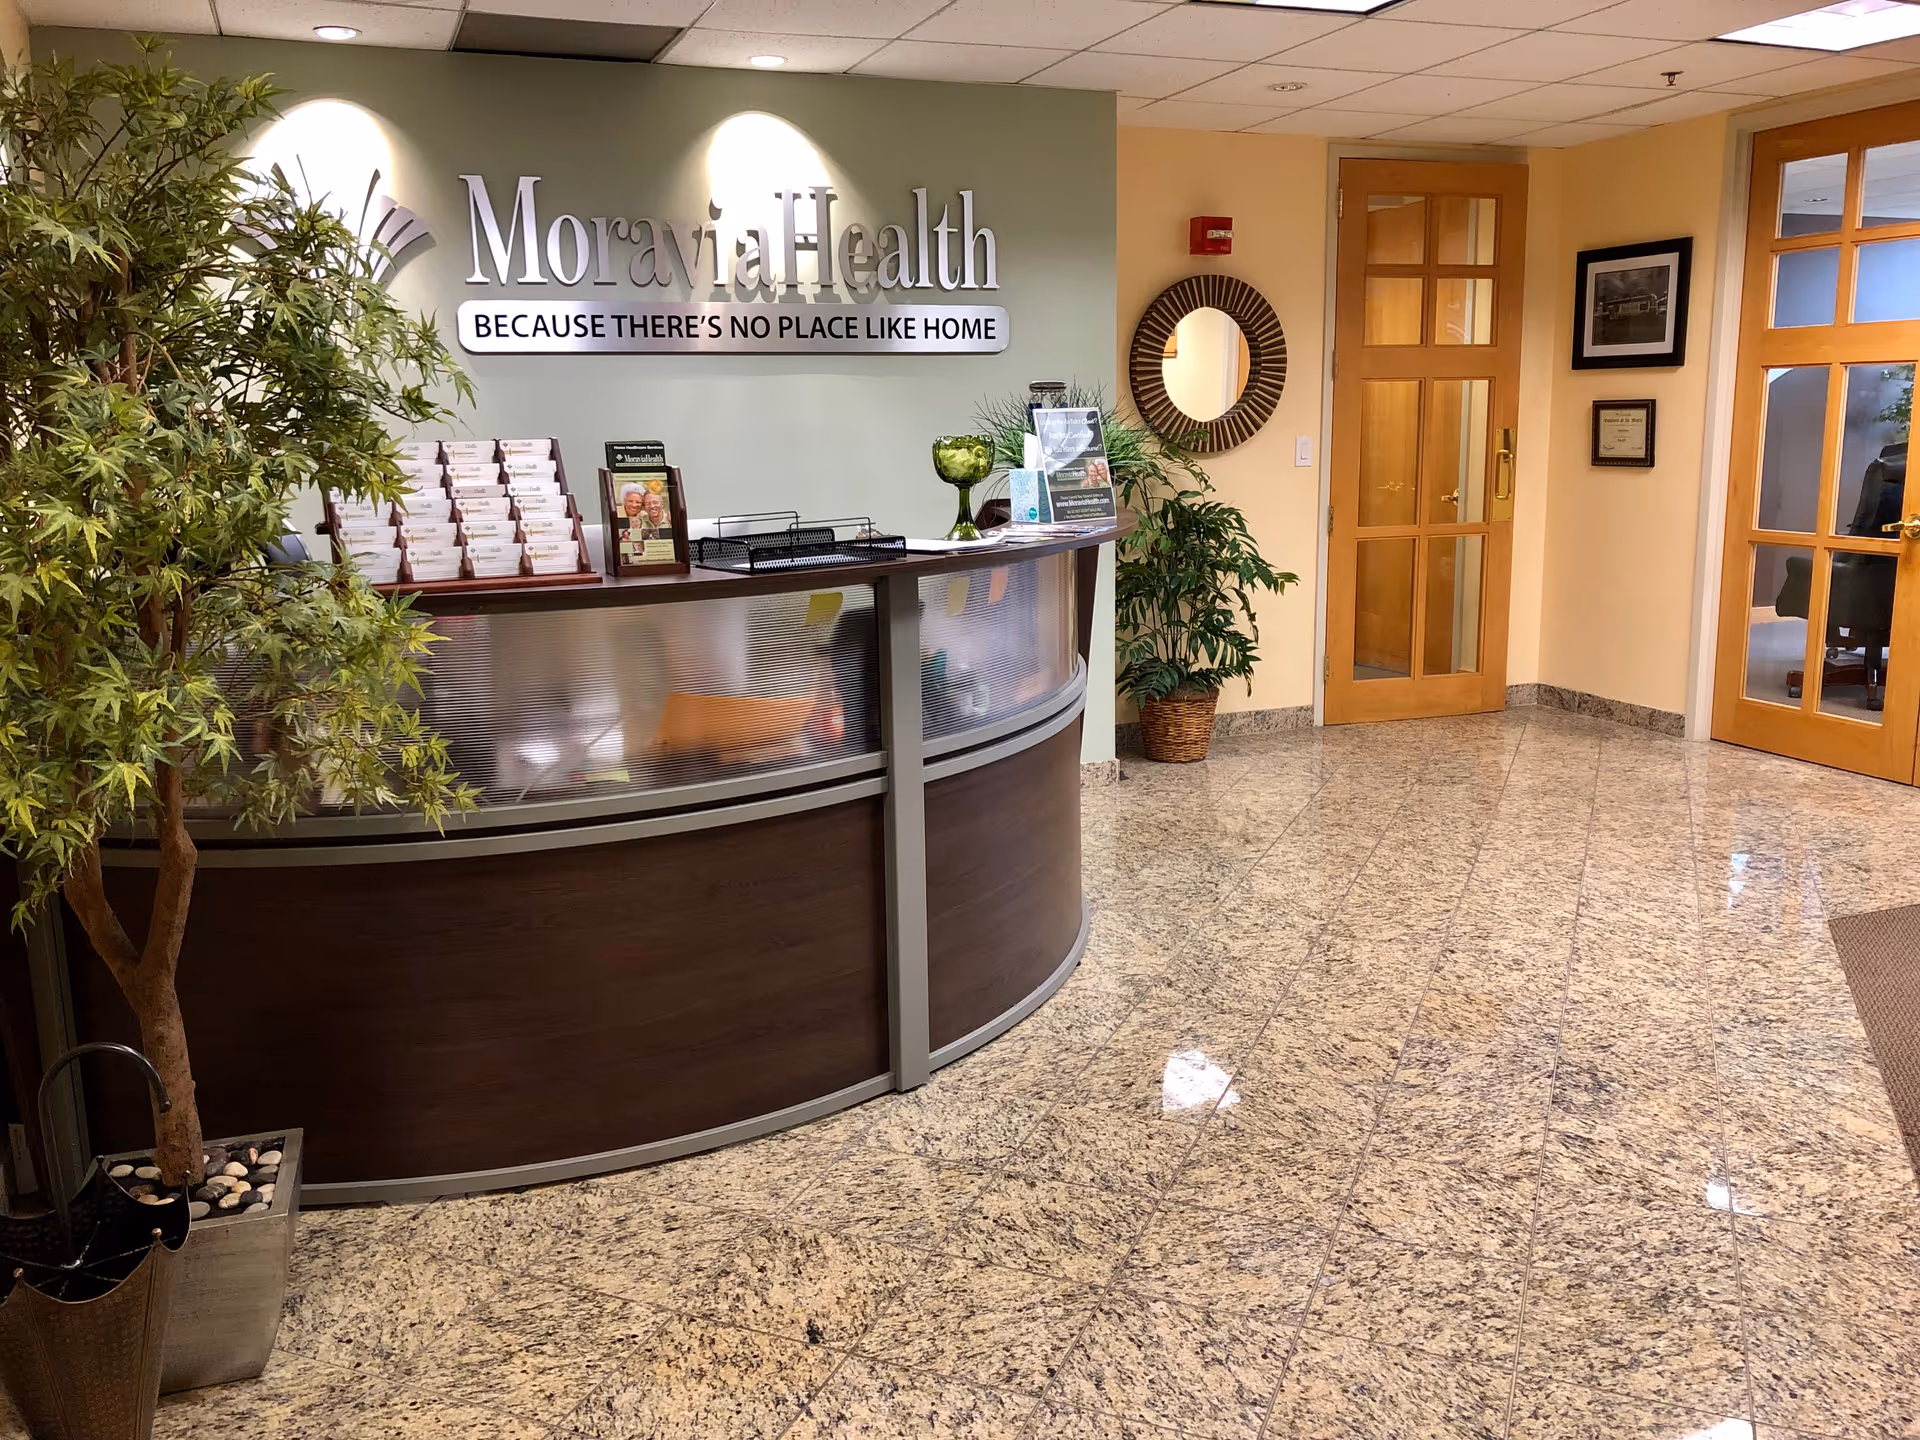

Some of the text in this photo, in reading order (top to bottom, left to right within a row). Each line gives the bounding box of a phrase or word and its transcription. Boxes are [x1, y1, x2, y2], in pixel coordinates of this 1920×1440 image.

[458, 174, 1000, 290] MoraviaHealth
[474, 313, 997, 341] BECAUSE THERE'S NO PLACE LIKE HOME
